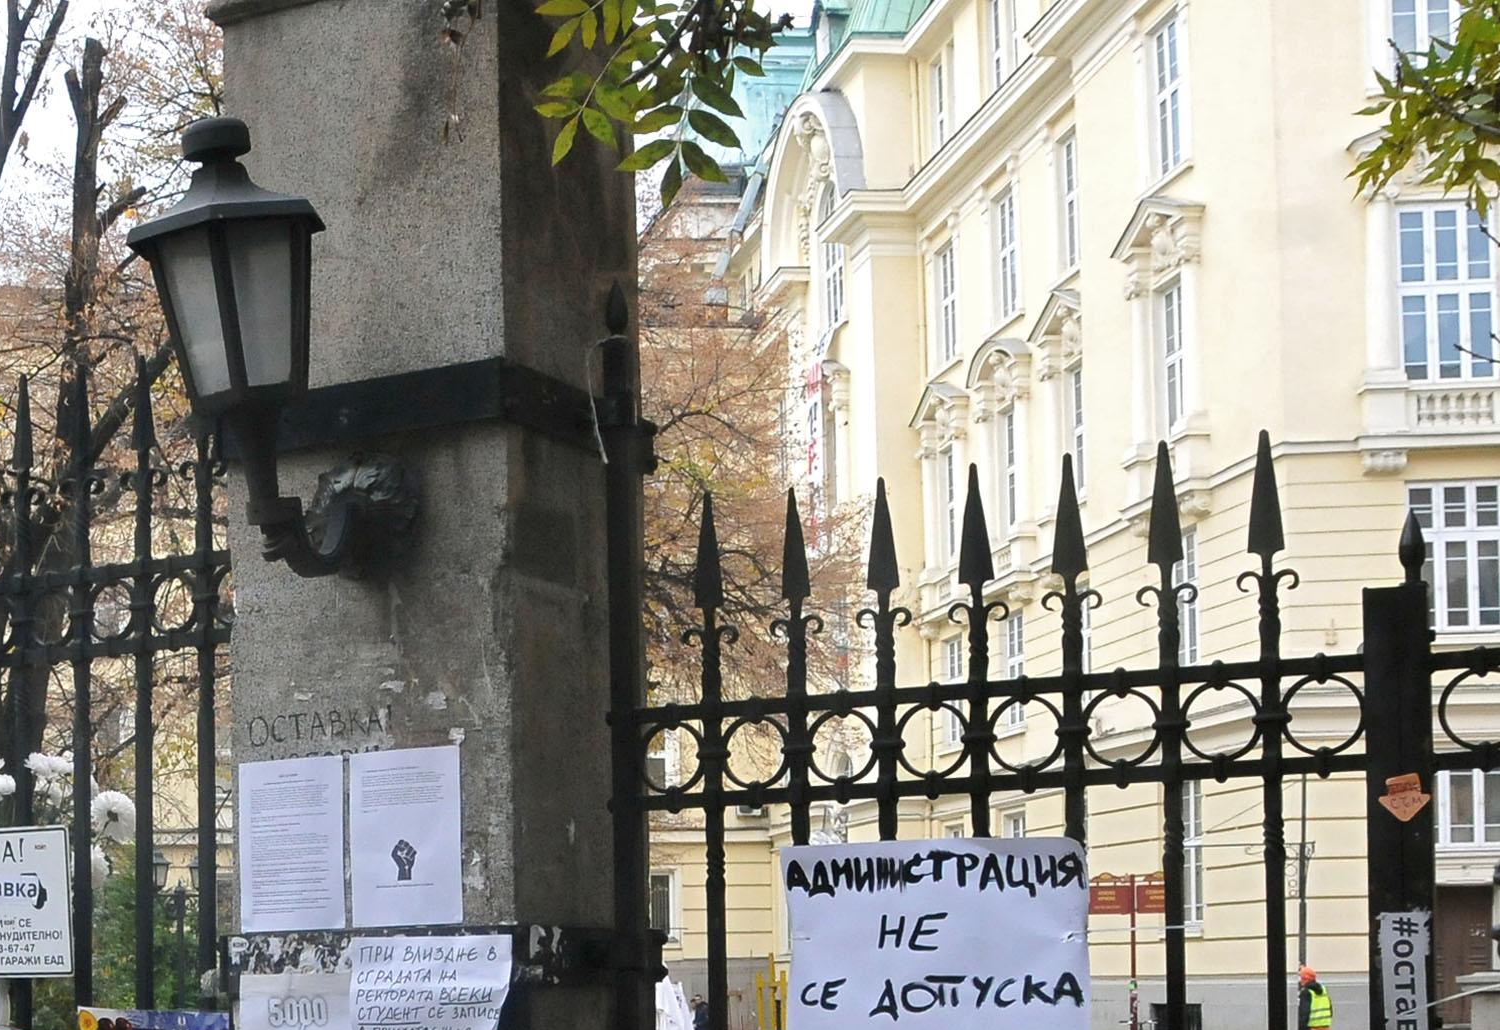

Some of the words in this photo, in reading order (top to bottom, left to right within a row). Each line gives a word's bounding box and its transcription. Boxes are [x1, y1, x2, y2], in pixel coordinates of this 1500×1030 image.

[249, 705, 393, 747] ОСТАВКА!
[786, 850, 1086, 898] АДМИНИСТРАЦИЯ
[18, 918, 32, 928] СЕ
[877, 911, 949, 951] НЕ
[0, 955, 41, 966] ГАРАЖИ
[44, 954, 65, 966] ЕАД
[359, 945, 395, 964] ПРИ
[486, 945, 498, 961] В
[356, 968, 432, 989] СГРАДАТА
[438, 969, 458, 984] НА
[355, 988, 434, 1005] РЕКТОРАТА
[439, 986, 493, 1003] ВСЕКИ
[800, 977, 847, 1010] СЕ
[868, 971, 1086, 1022] ДОПУСКА
[267, 996, 328, 1028] 5000
[357, 1005, 425, 1024] СТУДЕНТ
[427, 1006, 447, 1019] СЕ
